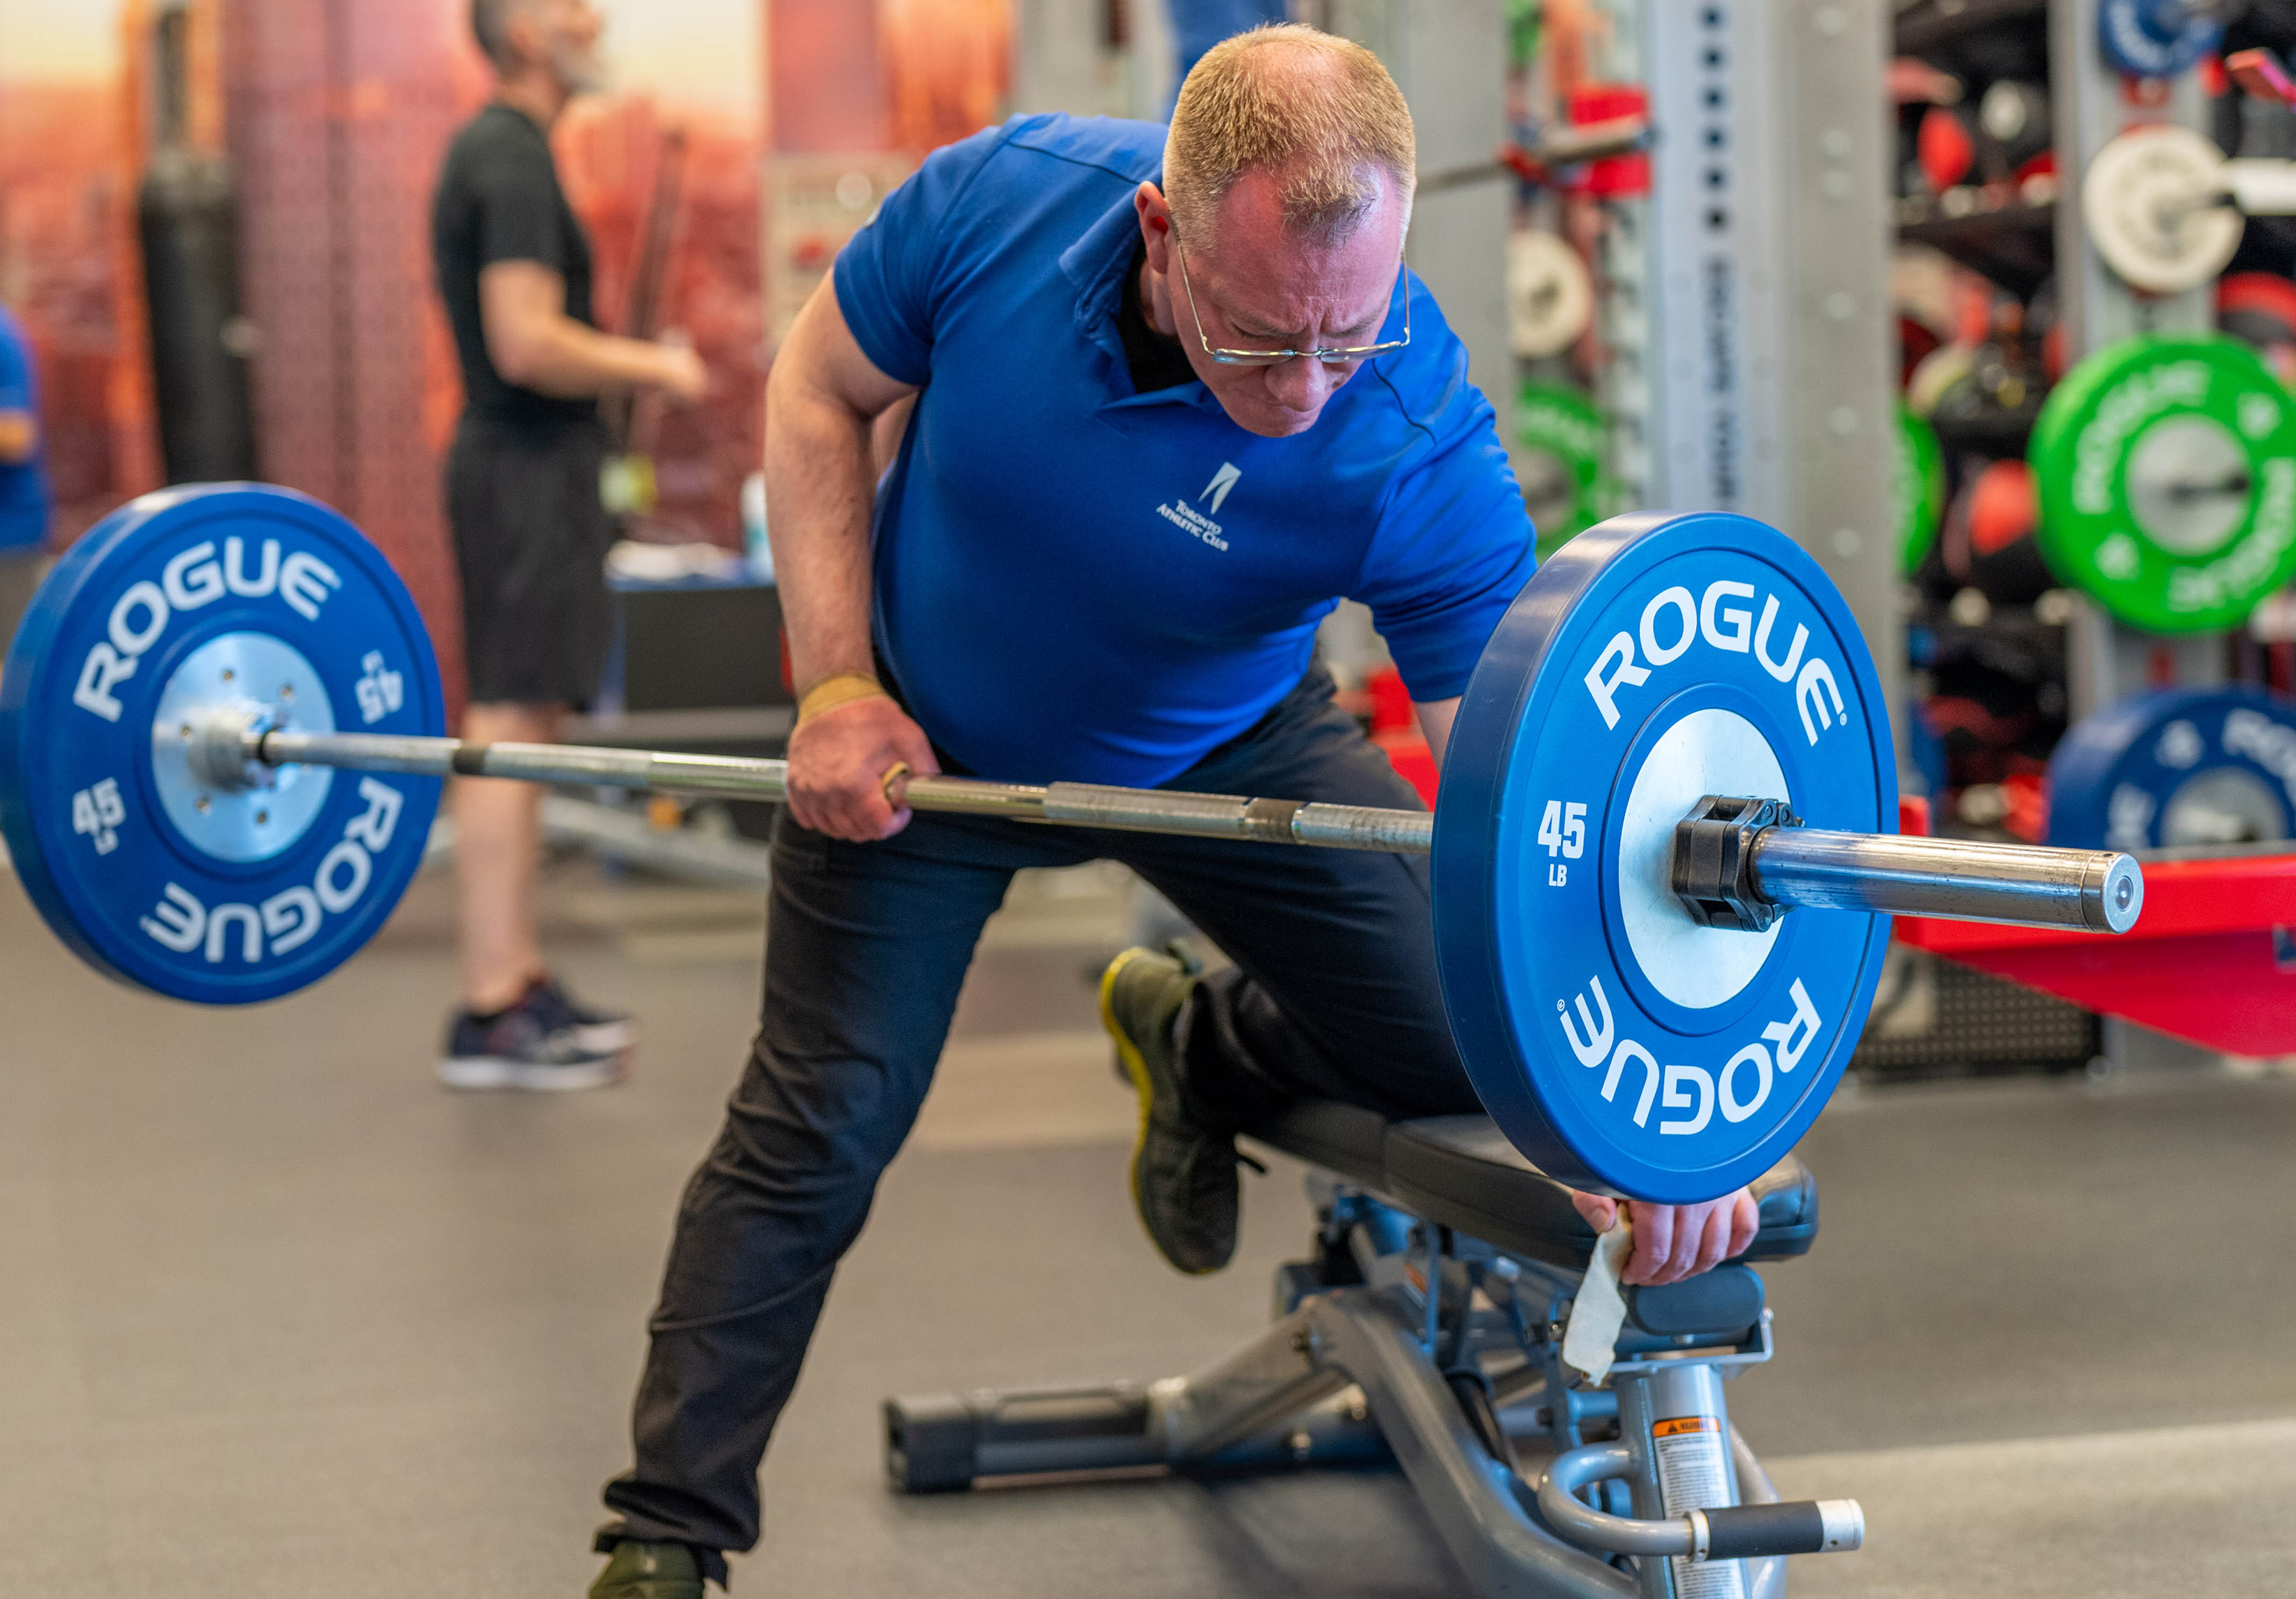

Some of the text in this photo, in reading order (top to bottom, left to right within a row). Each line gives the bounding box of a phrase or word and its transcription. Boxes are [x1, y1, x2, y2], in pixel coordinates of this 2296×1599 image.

[1156, 503, 1230, 552] ATHLETIC CLUB
[1175, 499, 1223, 535] TORONTO
[74, 536, 342, 722] ROGUE
[72, 776, 126, 835] 45
[1537, 800, 1588, 859] 45
[141, 777, 403, 963] ROGUE
[1548, 863, 1567, 887] LB
